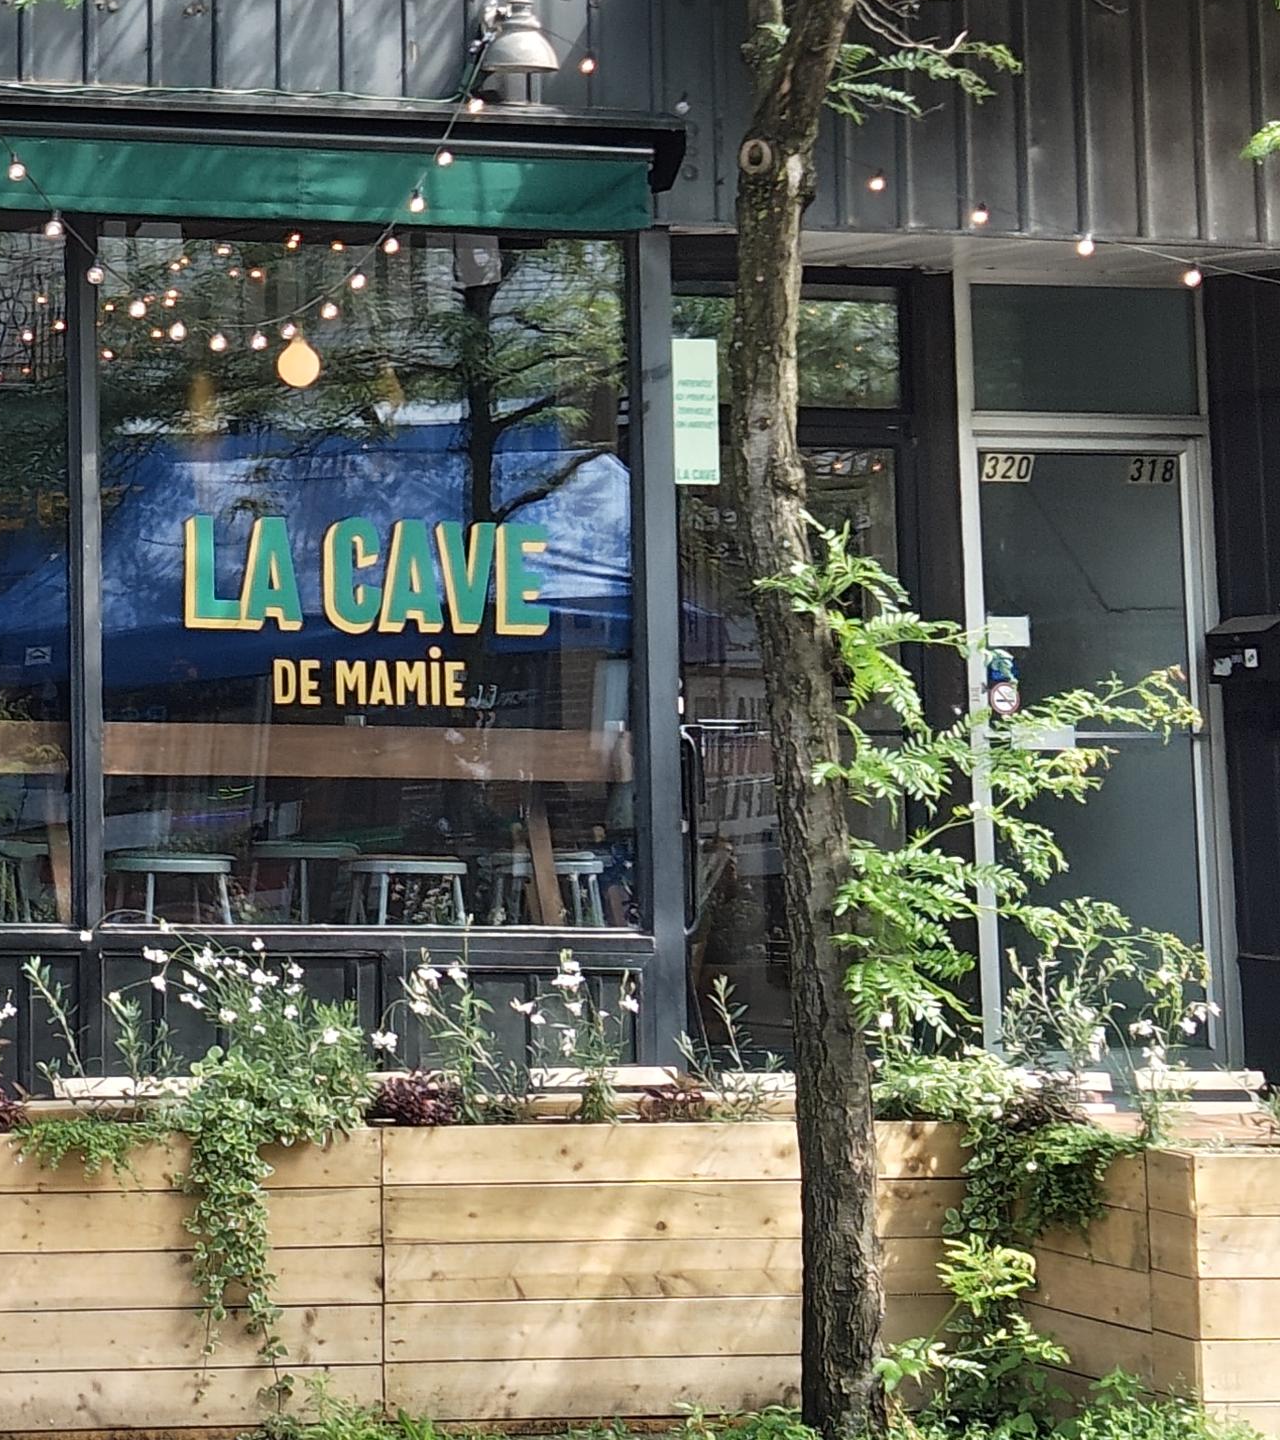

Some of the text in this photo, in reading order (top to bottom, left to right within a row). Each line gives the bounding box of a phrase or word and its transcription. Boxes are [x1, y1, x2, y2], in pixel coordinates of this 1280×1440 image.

[984, 455, 1032, 480] 320
[1130, 457, 1175, 483] 318
[185, 514, 551, 636] LA CAVE
[272, 658, 322, 706] DE
